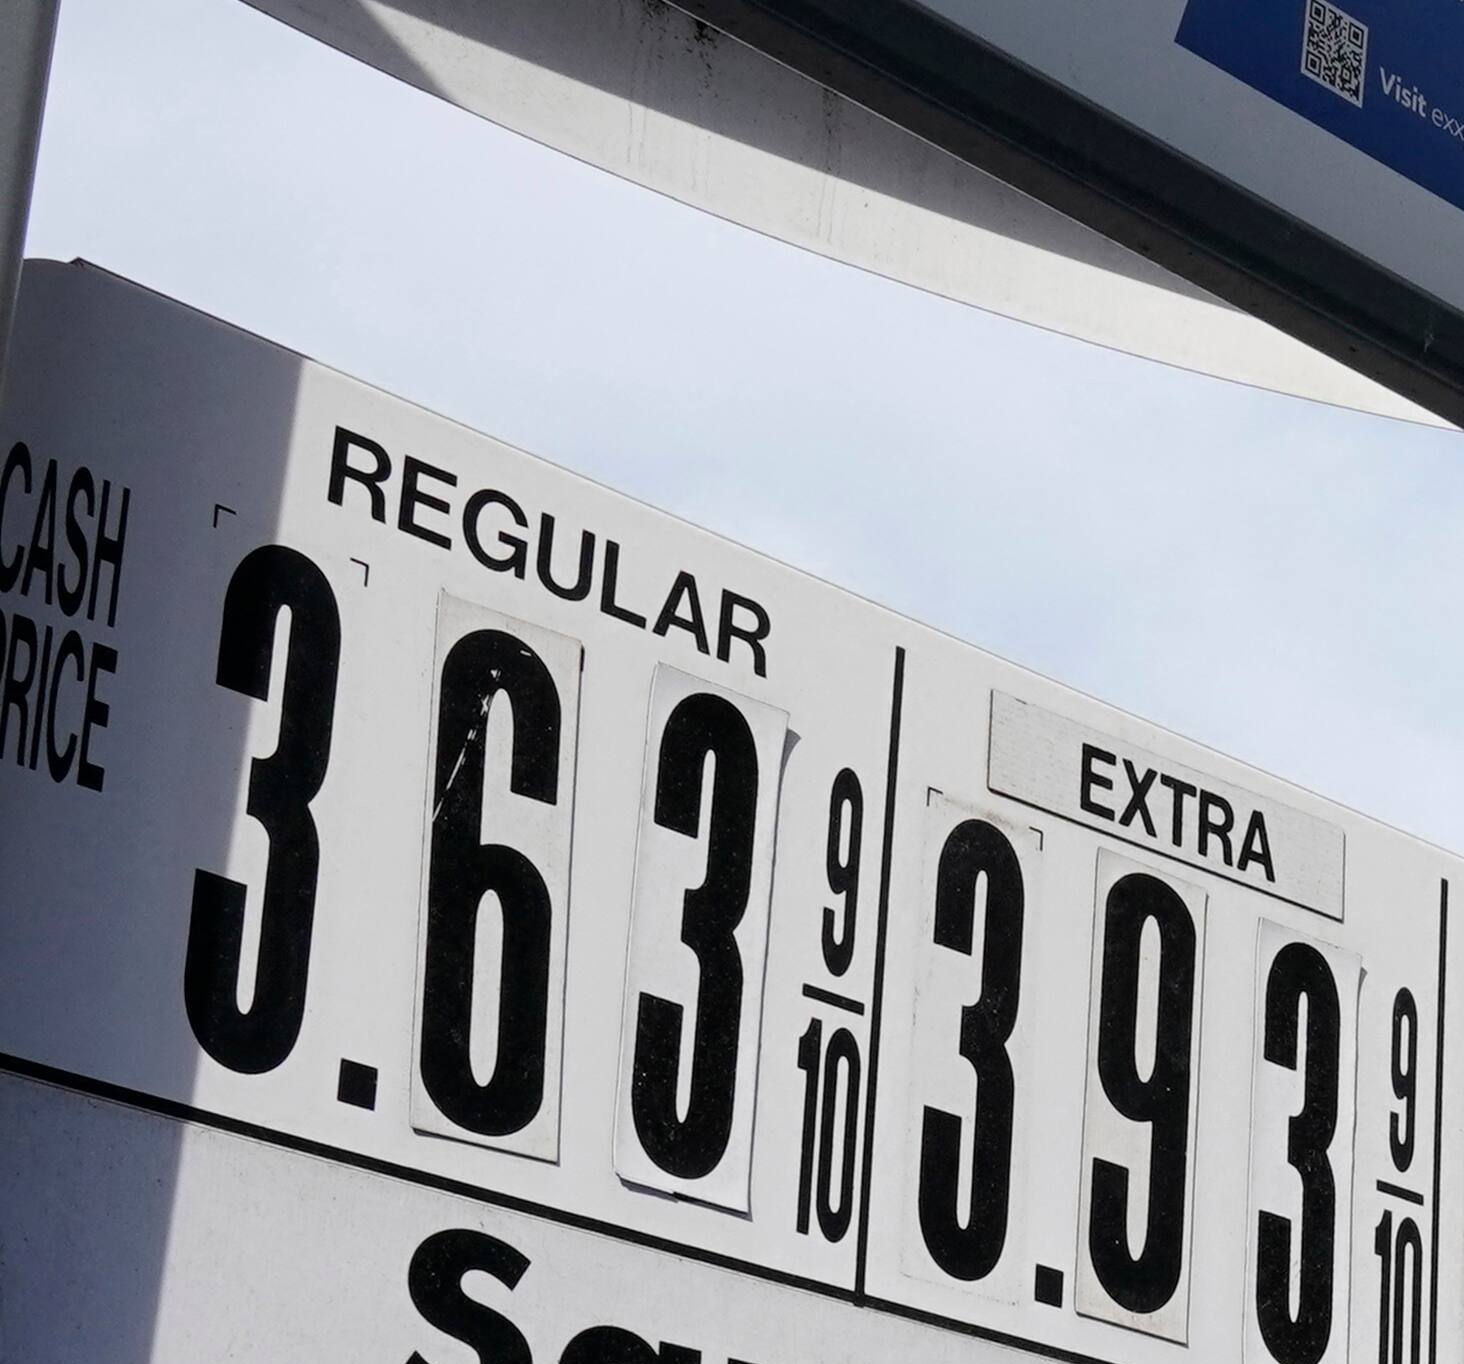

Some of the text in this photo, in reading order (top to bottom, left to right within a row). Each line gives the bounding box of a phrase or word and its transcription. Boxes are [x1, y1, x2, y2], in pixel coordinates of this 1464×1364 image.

[1379, 66, 1427, 118] Visit
[0, 441, 131, 628] CASH
[328, 425, 772, 678] REGULAR
[0, 606, 119, 793] RICE
[1080, 742, 1277, 883] EXTRA
